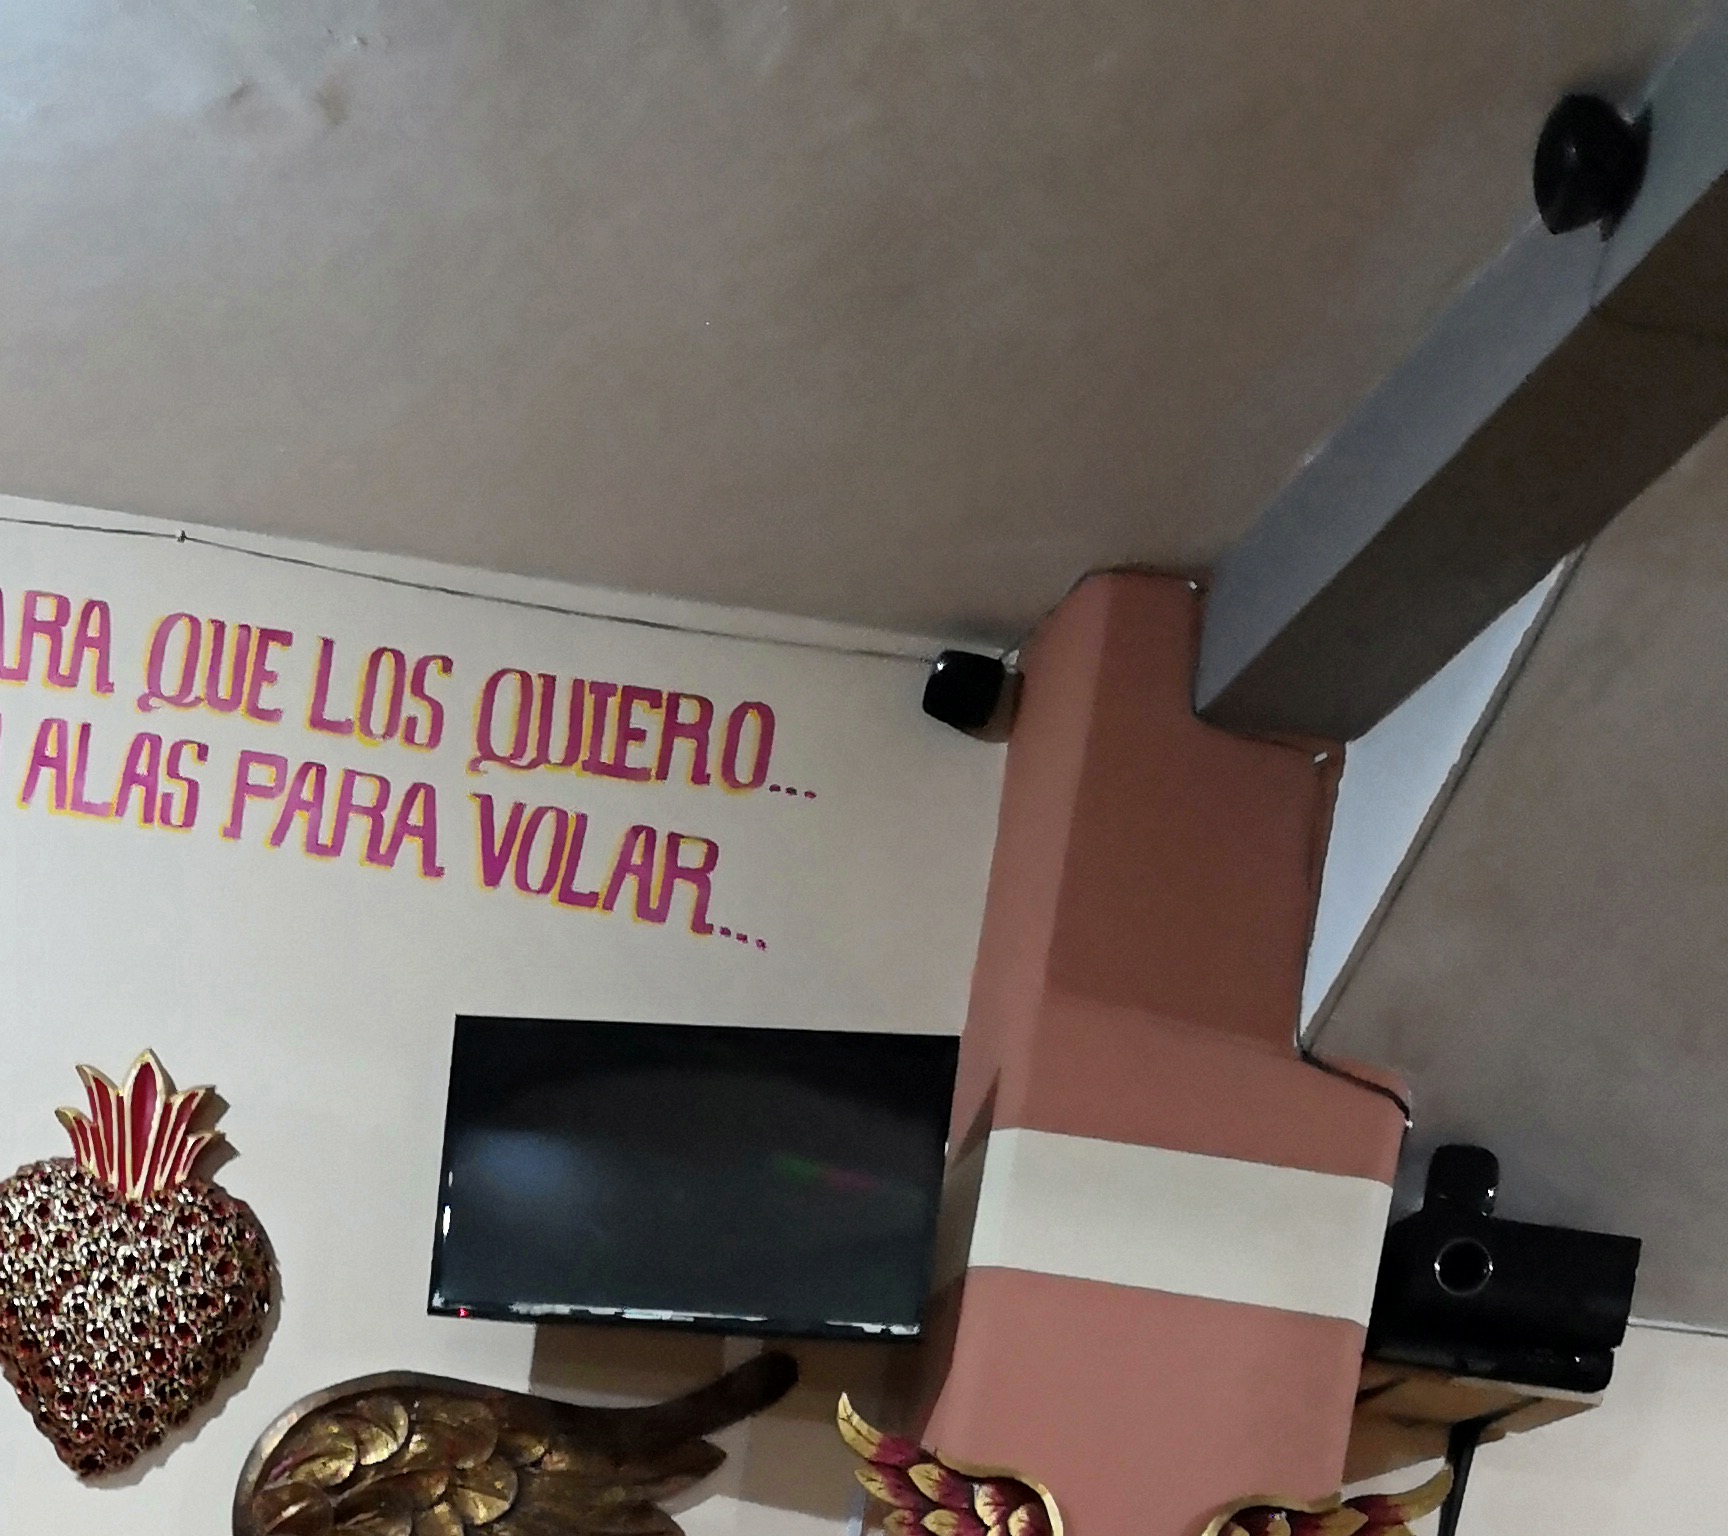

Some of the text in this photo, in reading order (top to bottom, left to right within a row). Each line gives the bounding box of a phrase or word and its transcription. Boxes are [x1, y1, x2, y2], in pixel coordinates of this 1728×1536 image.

[135, 613, 293, 726] QUE
[305, 637, 454, 753] LOS
[465, 669, 817, 799] QUIERO...
[16, 718, 209, 834] ALAS
[218, 750, 445, 881] PARA
[466, 793, 767, 951] VOLAR...
